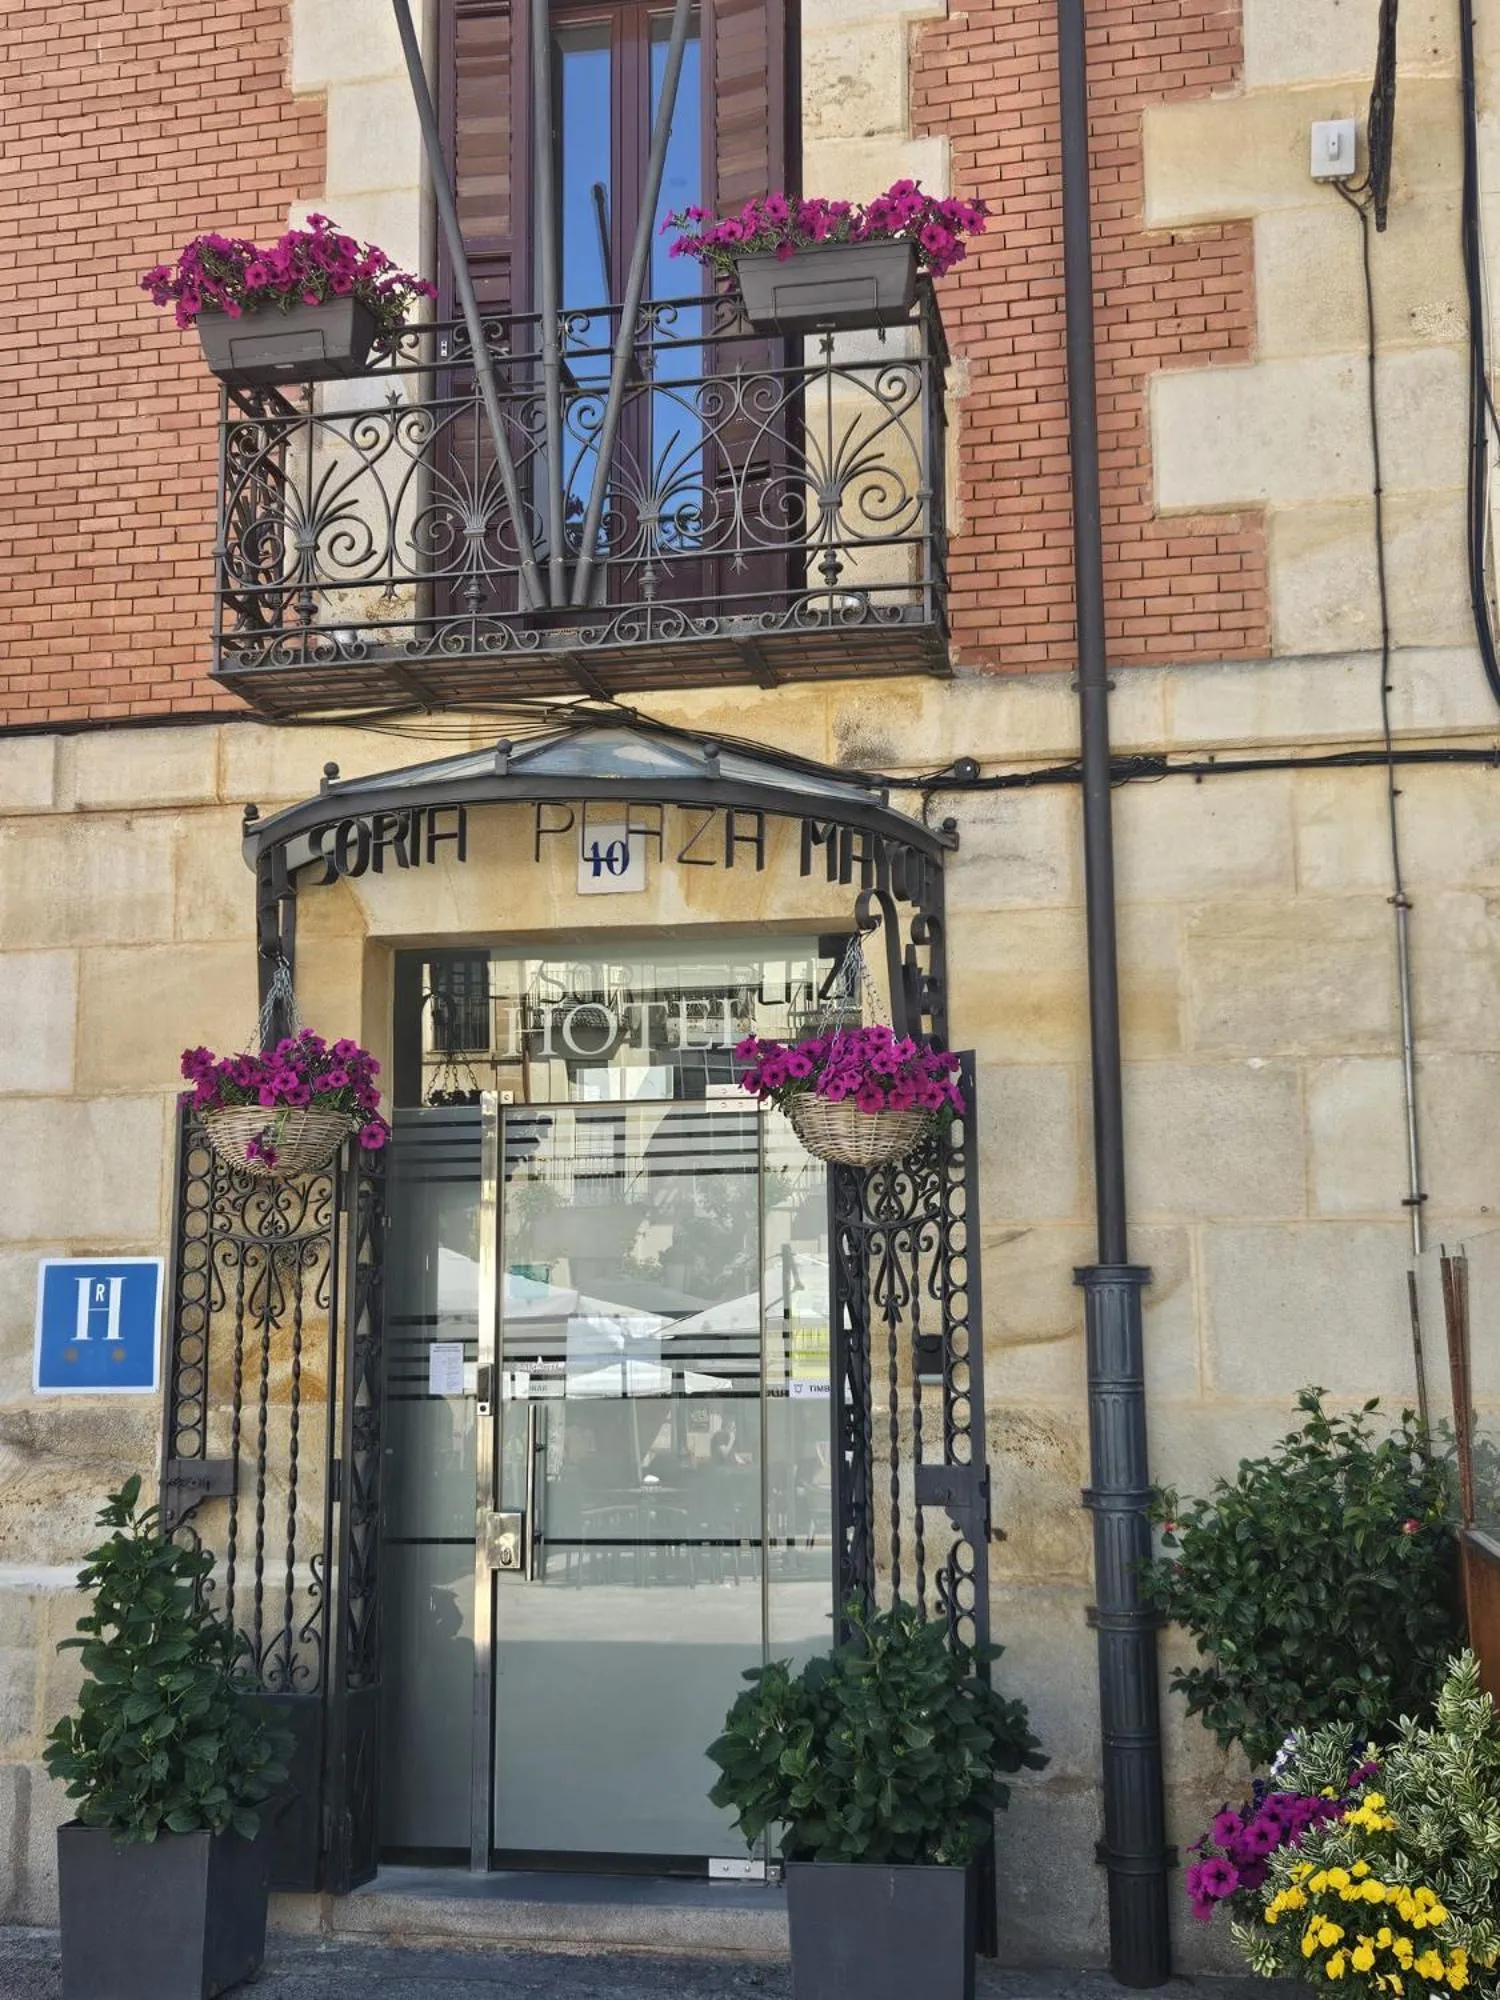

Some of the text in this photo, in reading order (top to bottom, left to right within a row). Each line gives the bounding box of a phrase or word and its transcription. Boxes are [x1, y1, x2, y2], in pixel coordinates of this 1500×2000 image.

[308, 803, 467, 886] SORIA
[532, 799, 764, 872] PLAZA
[591, 840, 629, 877] 10
[70, 1276, 127, 1341] H
[809, 1384, 832, 1393] TIMB
